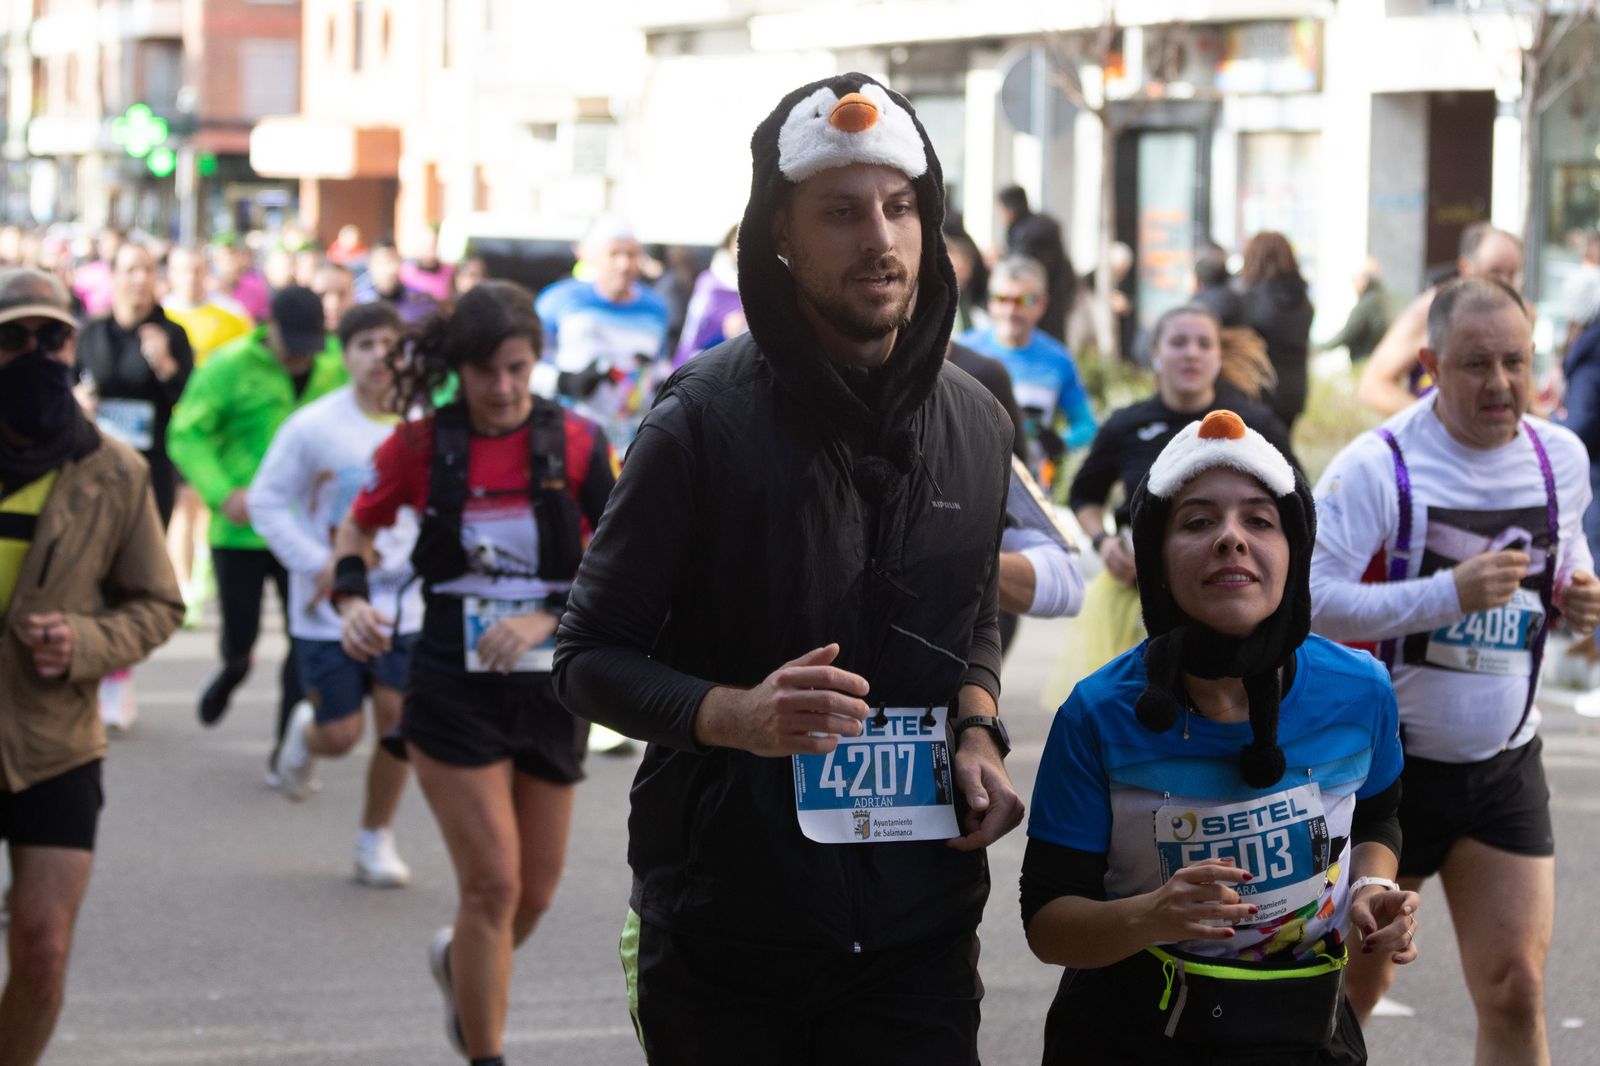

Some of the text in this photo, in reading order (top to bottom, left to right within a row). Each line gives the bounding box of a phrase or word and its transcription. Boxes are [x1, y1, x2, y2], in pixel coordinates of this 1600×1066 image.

[1446, 607, 1521, 645] 2408
[864, 715, 933, 737] ETEL
[819, 744, 915, 797] 4207
[854, 795, 893, 808] ADRIÁN
[873, 818, 913, 828] Ayuntamiento
[1201, 798, 1308, 836] SETEL
[873, 829, 913, 838] de Salamanca
[1236, 885, 1258, 897] ARA
[1254, 908, 1287, 921] Salamanca
